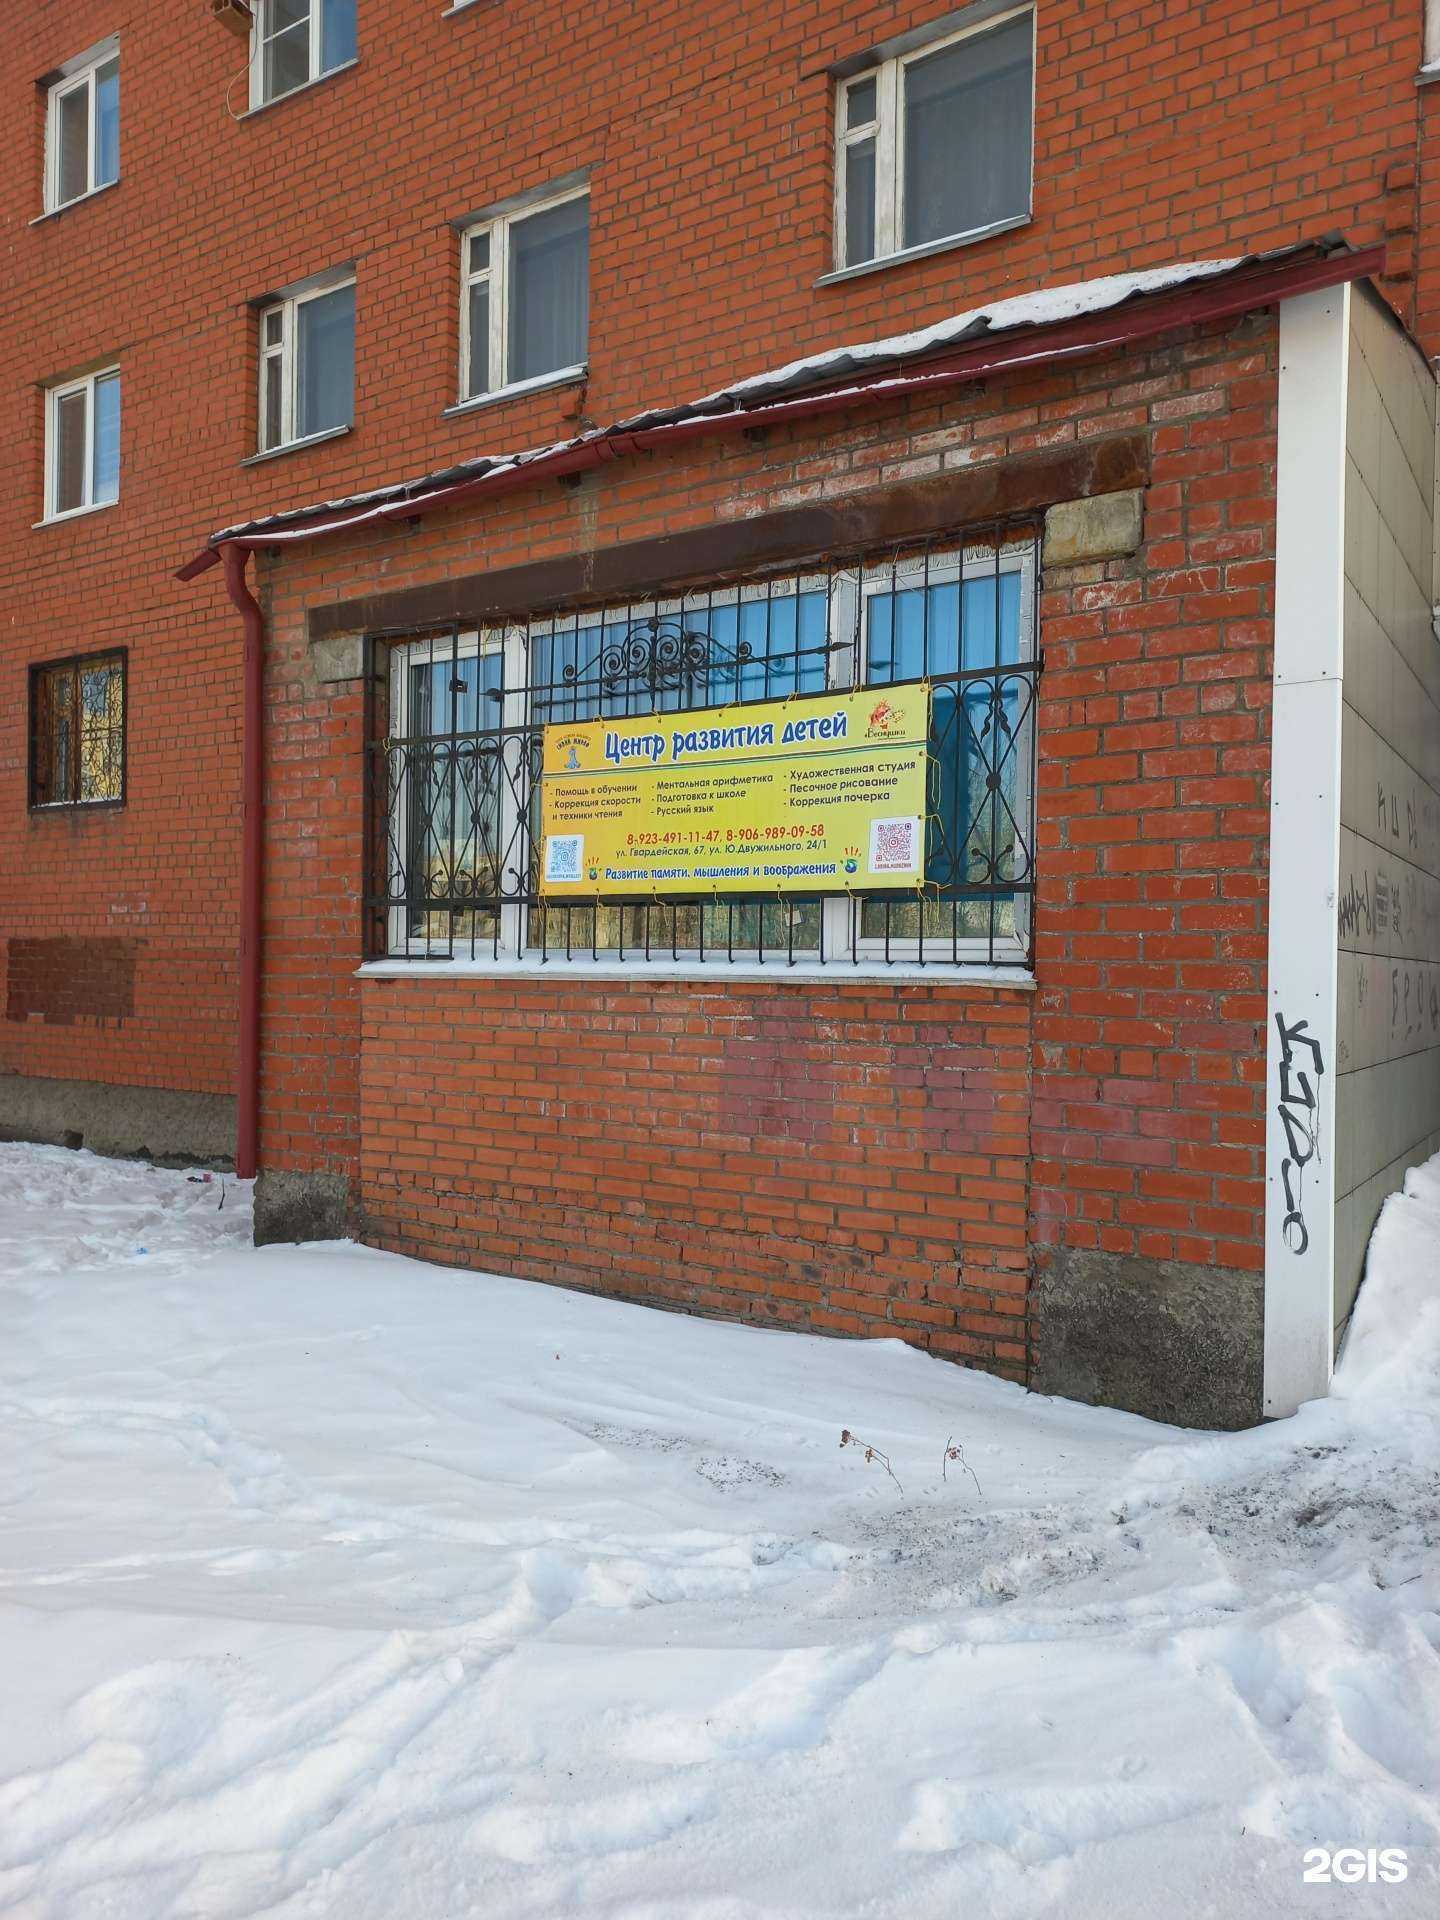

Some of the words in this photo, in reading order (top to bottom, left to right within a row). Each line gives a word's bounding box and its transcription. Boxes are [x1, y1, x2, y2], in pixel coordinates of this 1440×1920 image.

[605, 732, 666, 764] Центр
[672, 723, 774, 761] развития
[781, 711, 848, 744] детей
[790, 765, 875, 781] Художественная
[877, 760, 917, 773] студия
[555, 788, 589, 797] Помощь
[597, 784, 638, 797] обучении
[656, 779, 710, 791] Ментальная
[712, 774, 774, 789] арифметика
[789, 781, 838, 794] Песочное
[839, 776, 899, 792] рисование
[554, 799, 599, 810] Коррекция
[600, 796, 641, 809] скорости
[656, 792, 708, 804] Подготовка
[709, 792, 715, 800] к
[717, 789, 747, 800] школе
[789, 794, 842, 809] Коррекция
[843, 791, 891, 805] почерка
[559, 811, 593, 821] техники
[594, 809, 623, 819] чтения
[656, 803, 692, 817] Русский
[693, 804, 714, 814] язык
[626, 830, 723, 846] 8-923-491-11-47,
[726, 823, 825, 842] 8-906-989-09-58
[616, 849, 627, 859] ул.
[629, 846, 692, 858] Гвардейская,
[693, 844, 706, 856] 67,
[709, 846, 722, 856] ул.
[806, 838, 828, 851] 24/1
[605, 867, 649, 881] Развитие
[693, 864, 749, 878] мышления
[752, 864, 760, 876] и
[763, 863, 836, 878] воображения
